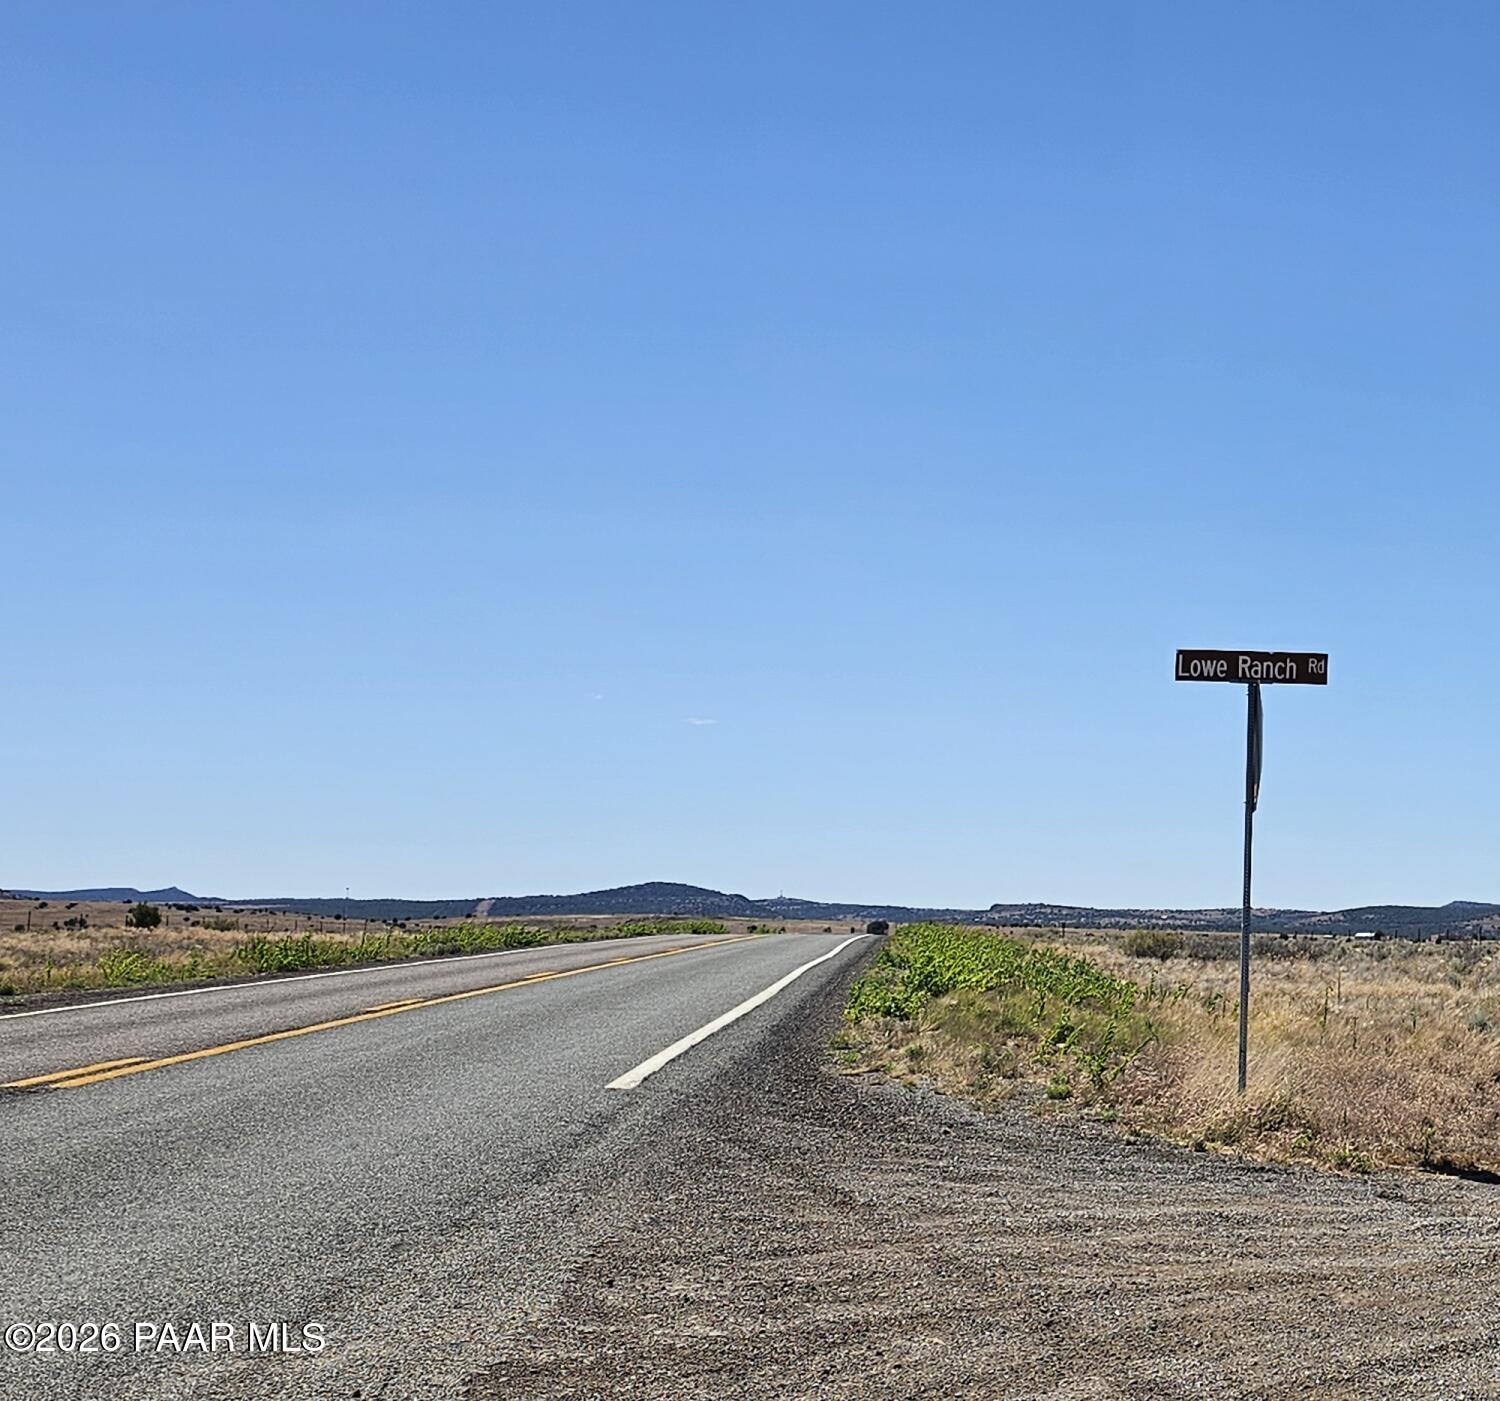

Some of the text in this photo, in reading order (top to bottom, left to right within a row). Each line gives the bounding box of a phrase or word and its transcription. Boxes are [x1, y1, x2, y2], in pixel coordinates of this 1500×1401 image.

[1178, 654, 1325, 680] Lowe Ranch Rd
